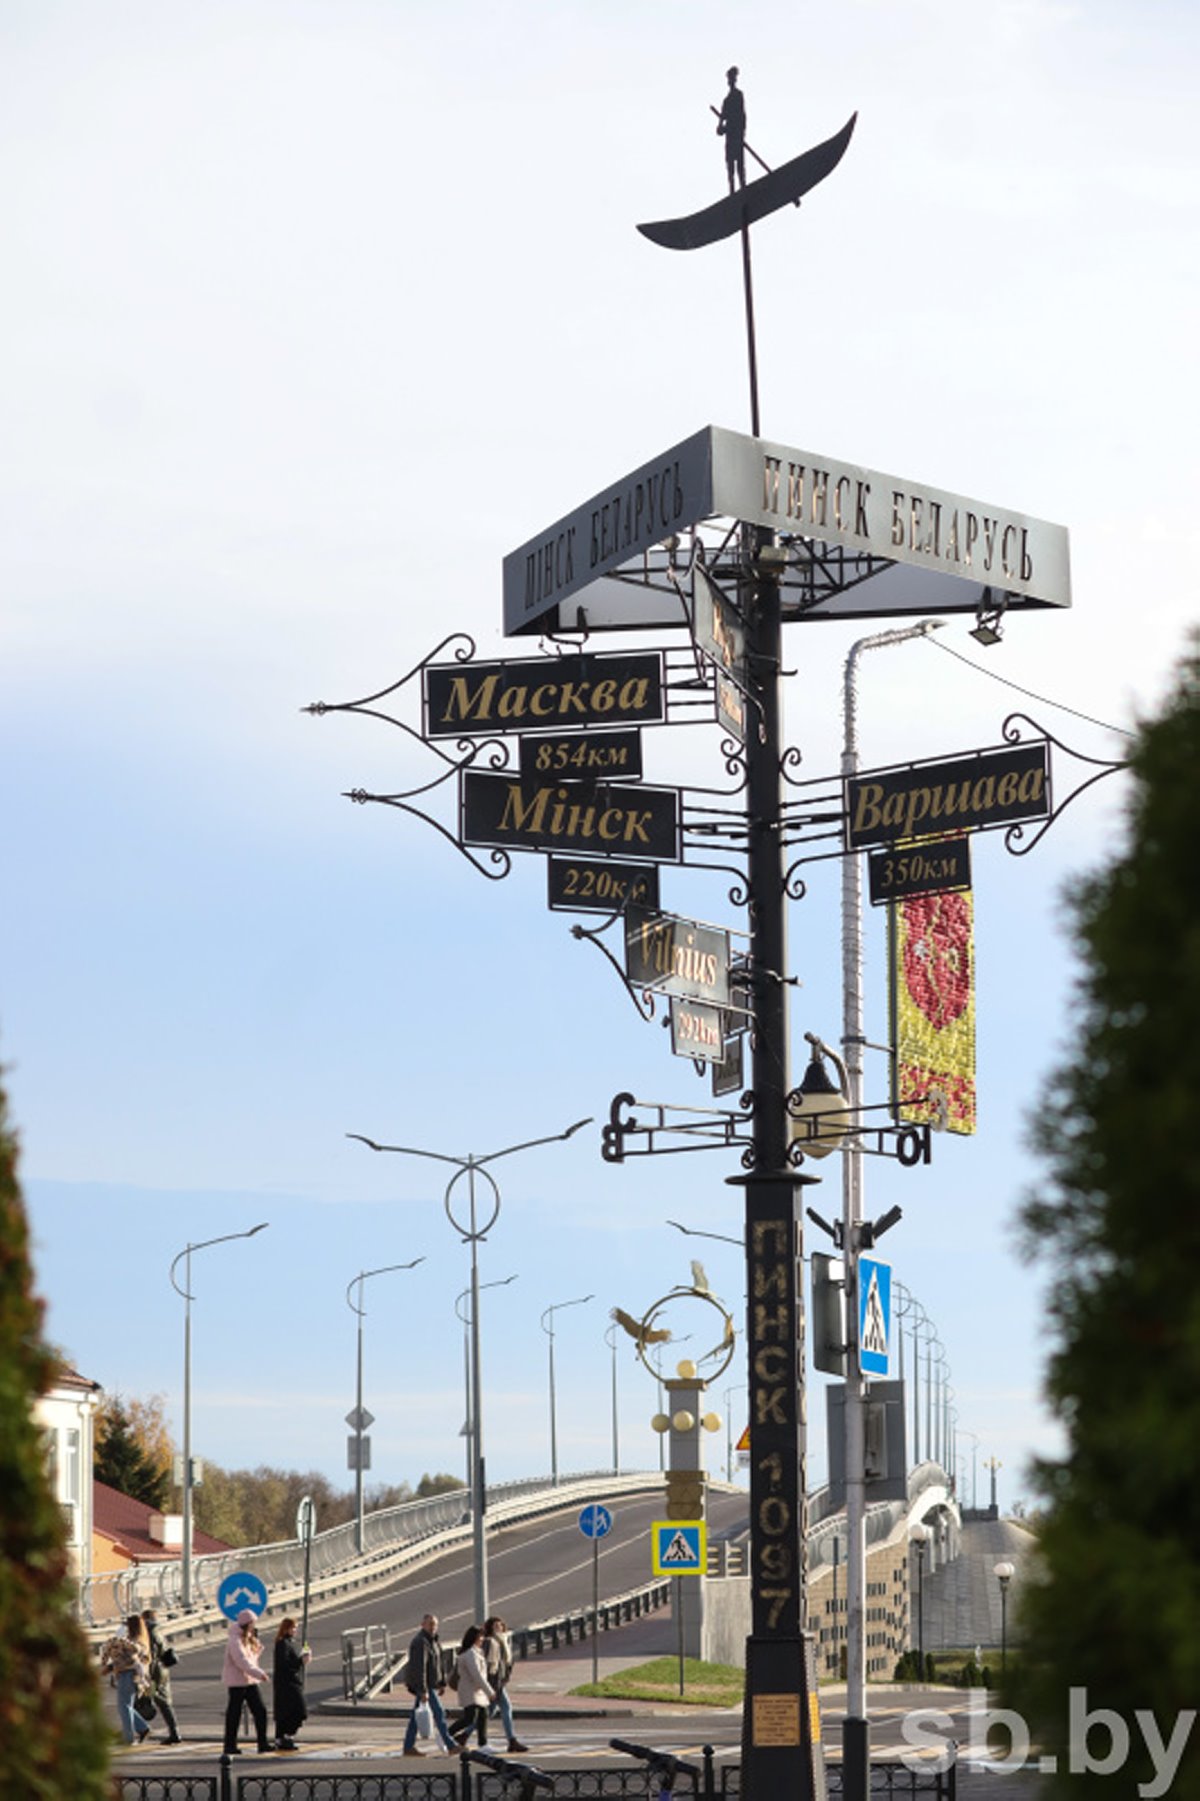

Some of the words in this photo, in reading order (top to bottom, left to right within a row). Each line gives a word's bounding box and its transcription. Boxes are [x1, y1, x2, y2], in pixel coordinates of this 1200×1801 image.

[591, 461, 683, 568] БЕЛАРУСЬ
[762, 455, 871, 538] ПИНСК
[892, 490, 1032, 581] БЕЛАРУСЬ
[440, 674, 649, 722] Масква
[535, 741, 627, 769] 854км
[496, 784, 652, 842] Мінск
[852, 765, 1044, 836] Варшава
[881, 855, 957, 887] 350км
[641, 920, 718, 987] Vilnius
[753, 1220, 789, 1424] ПИНСК
[758, 1452, 792, 1630] 1097
